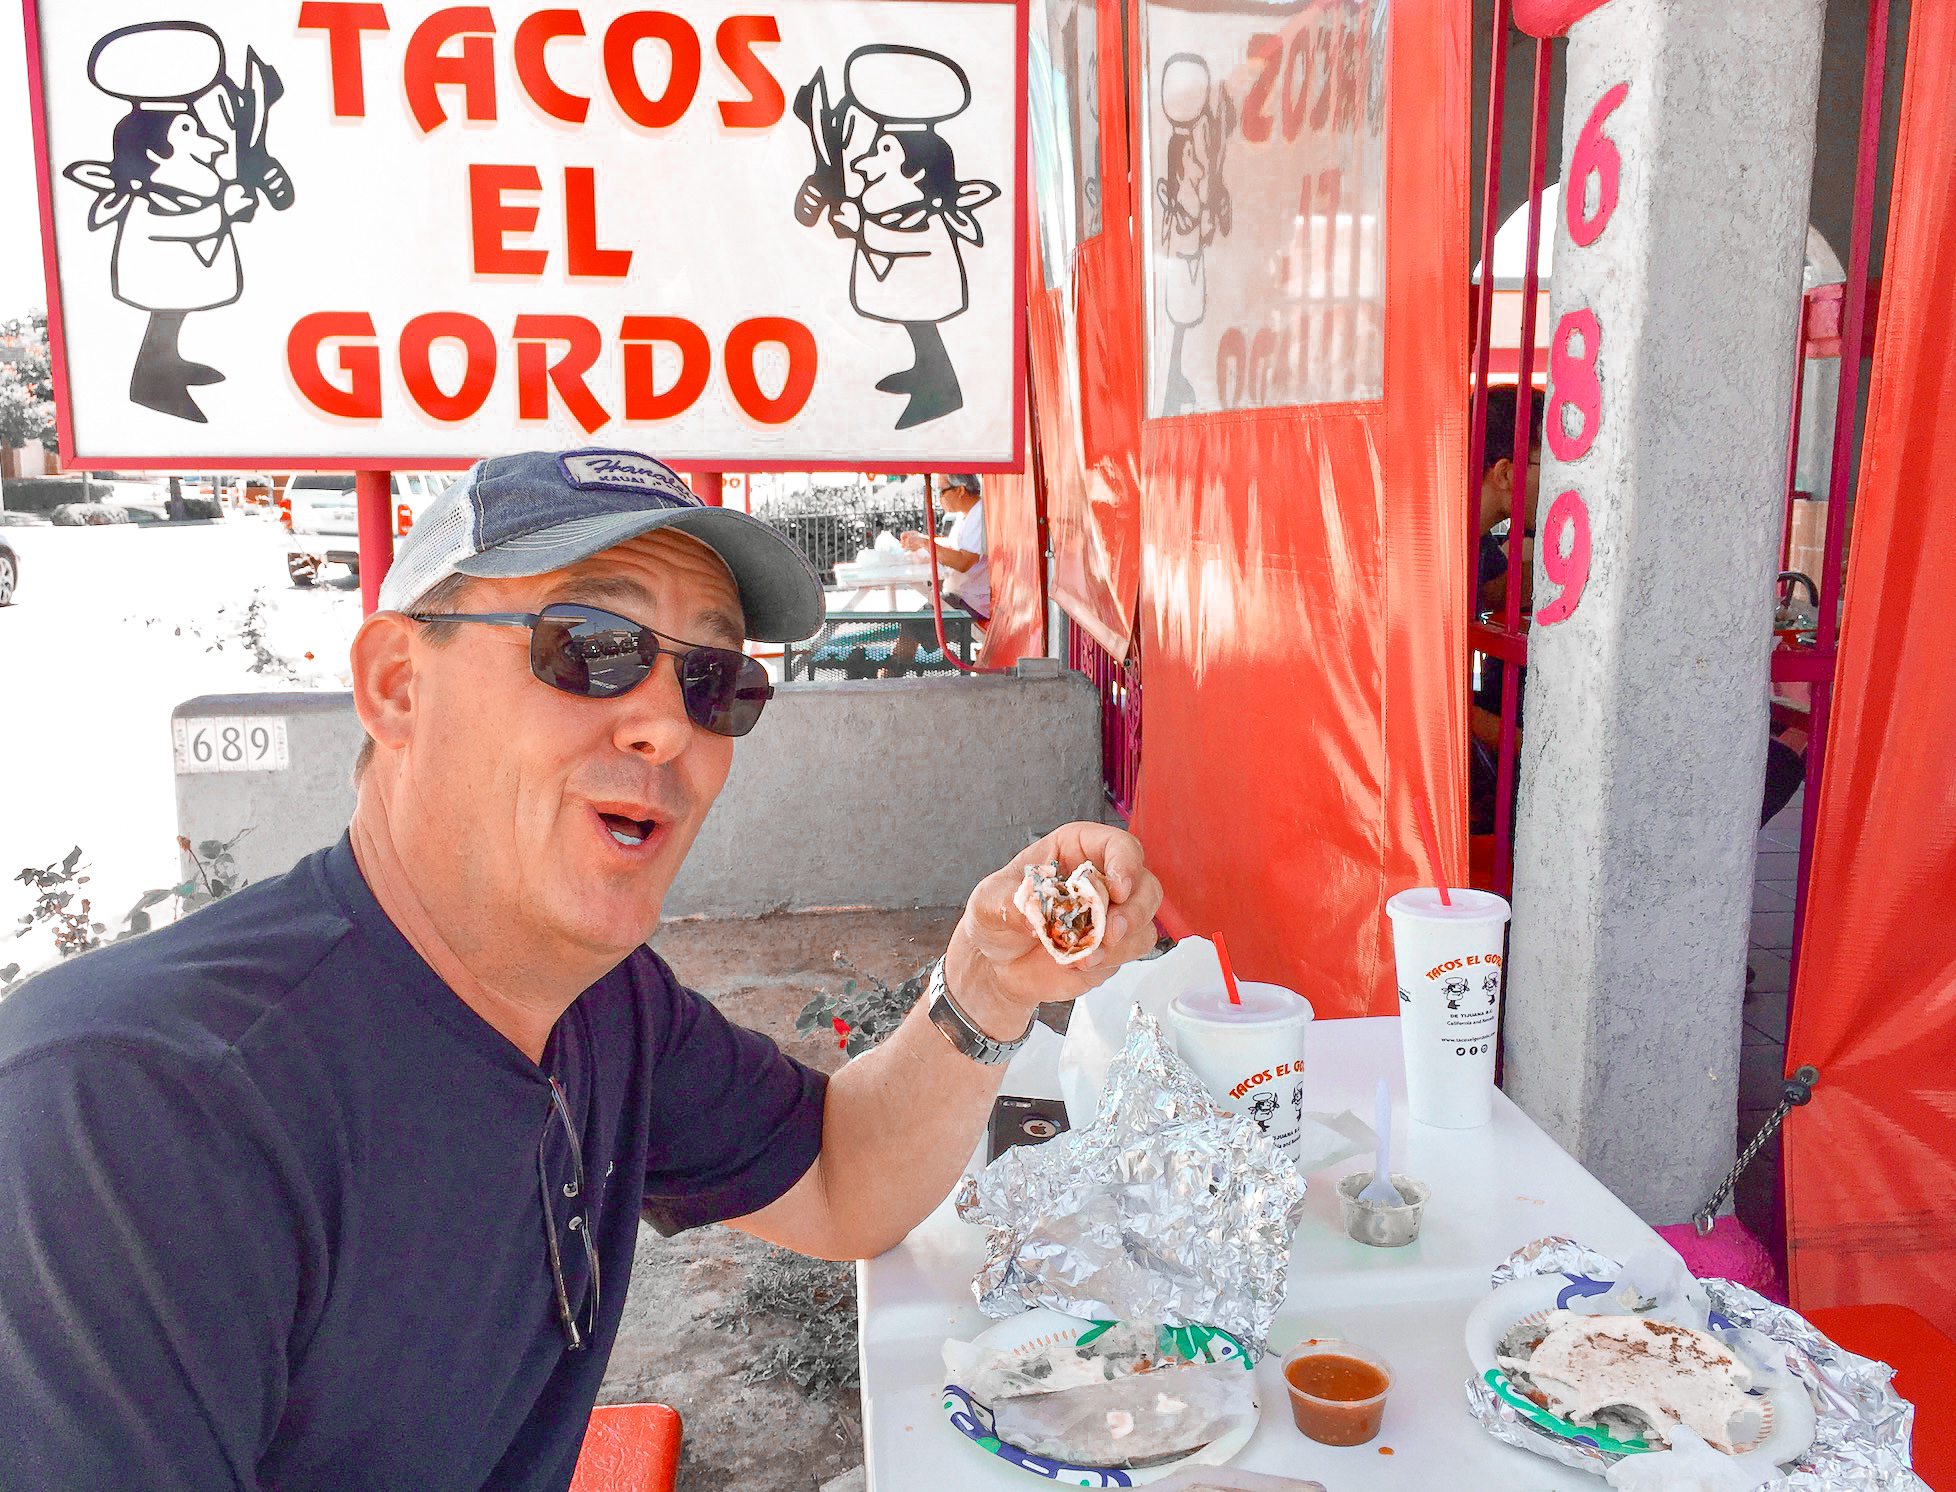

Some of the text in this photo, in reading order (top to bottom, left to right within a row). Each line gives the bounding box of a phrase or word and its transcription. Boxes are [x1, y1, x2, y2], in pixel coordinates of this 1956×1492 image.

[298, 2, 785, 133] TACOS
[469, 164, 633, 278] EL
[287, 311, 818, 435] GORDO
[1537, 82, 1630, 627] 689
[193, 727, 269, 762] 689
[1425, 954, 1502, 981] TACOS EL GOR
[1229, 1069, 1273, 1100] TACOS
[1276, 1063, 1291, 1077] EL
